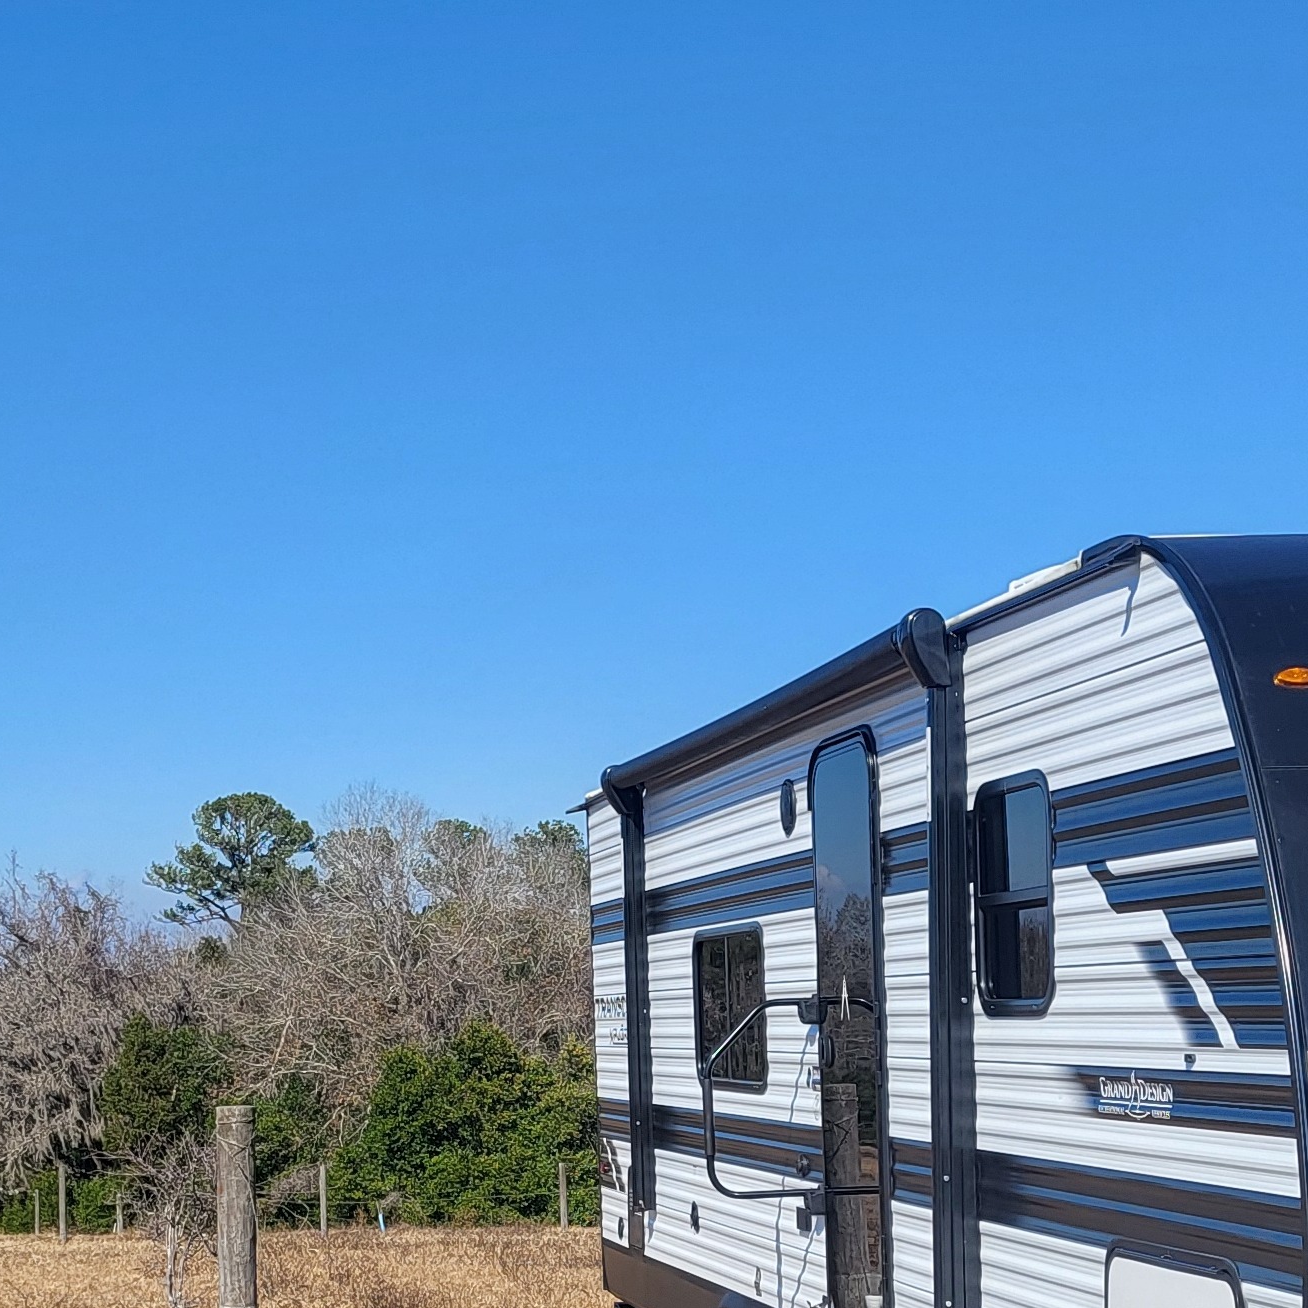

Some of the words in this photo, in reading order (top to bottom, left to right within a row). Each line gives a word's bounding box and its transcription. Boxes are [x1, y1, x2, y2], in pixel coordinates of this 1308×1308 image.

[595, 995, 627, 1018] TRANSC
[1099, 1076, 1132, 1099] GRAND
[1137, 1079, 1173, 1102] DESIGN
